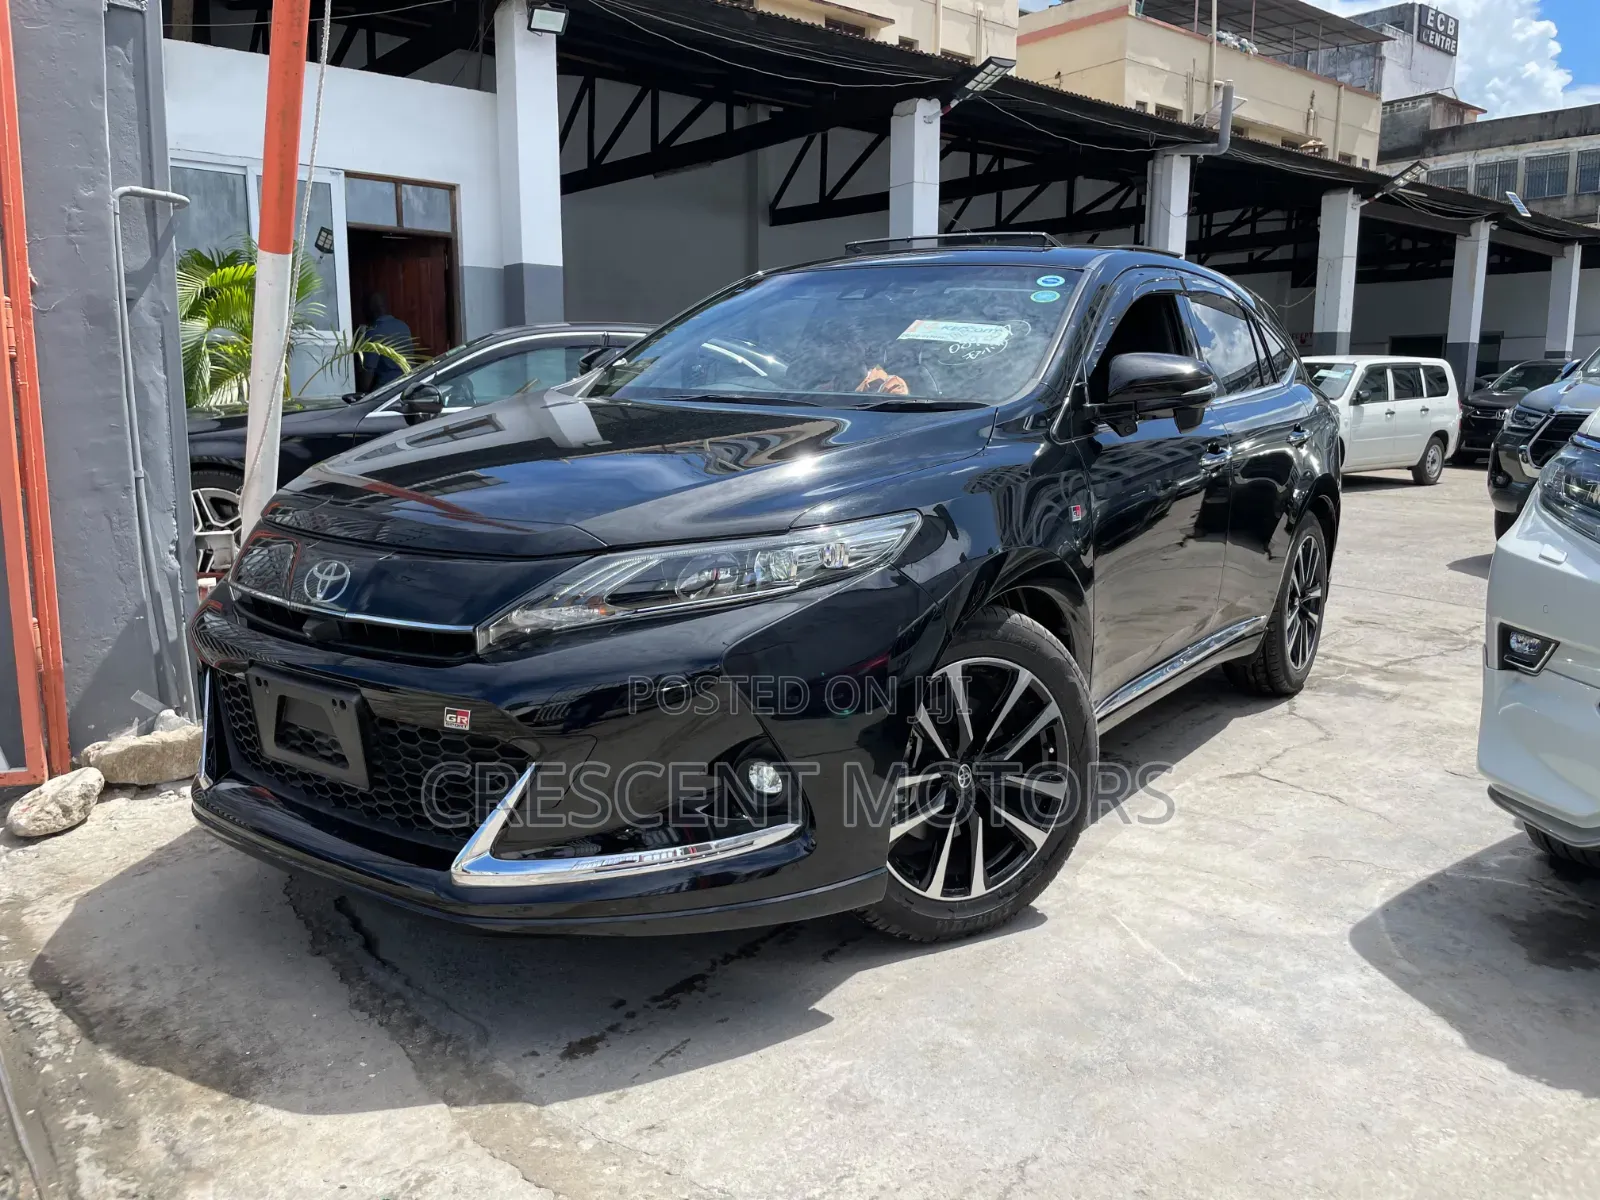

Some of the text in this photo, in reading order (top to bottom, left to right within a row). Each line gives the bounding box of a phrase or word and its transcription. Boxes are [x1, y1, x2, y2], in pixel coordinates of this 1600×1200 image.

[1426, 8, 1456, 36] ECB
[1422, 30, 1457, 53] CENTRE
[446, 713, 468, 725] GR
